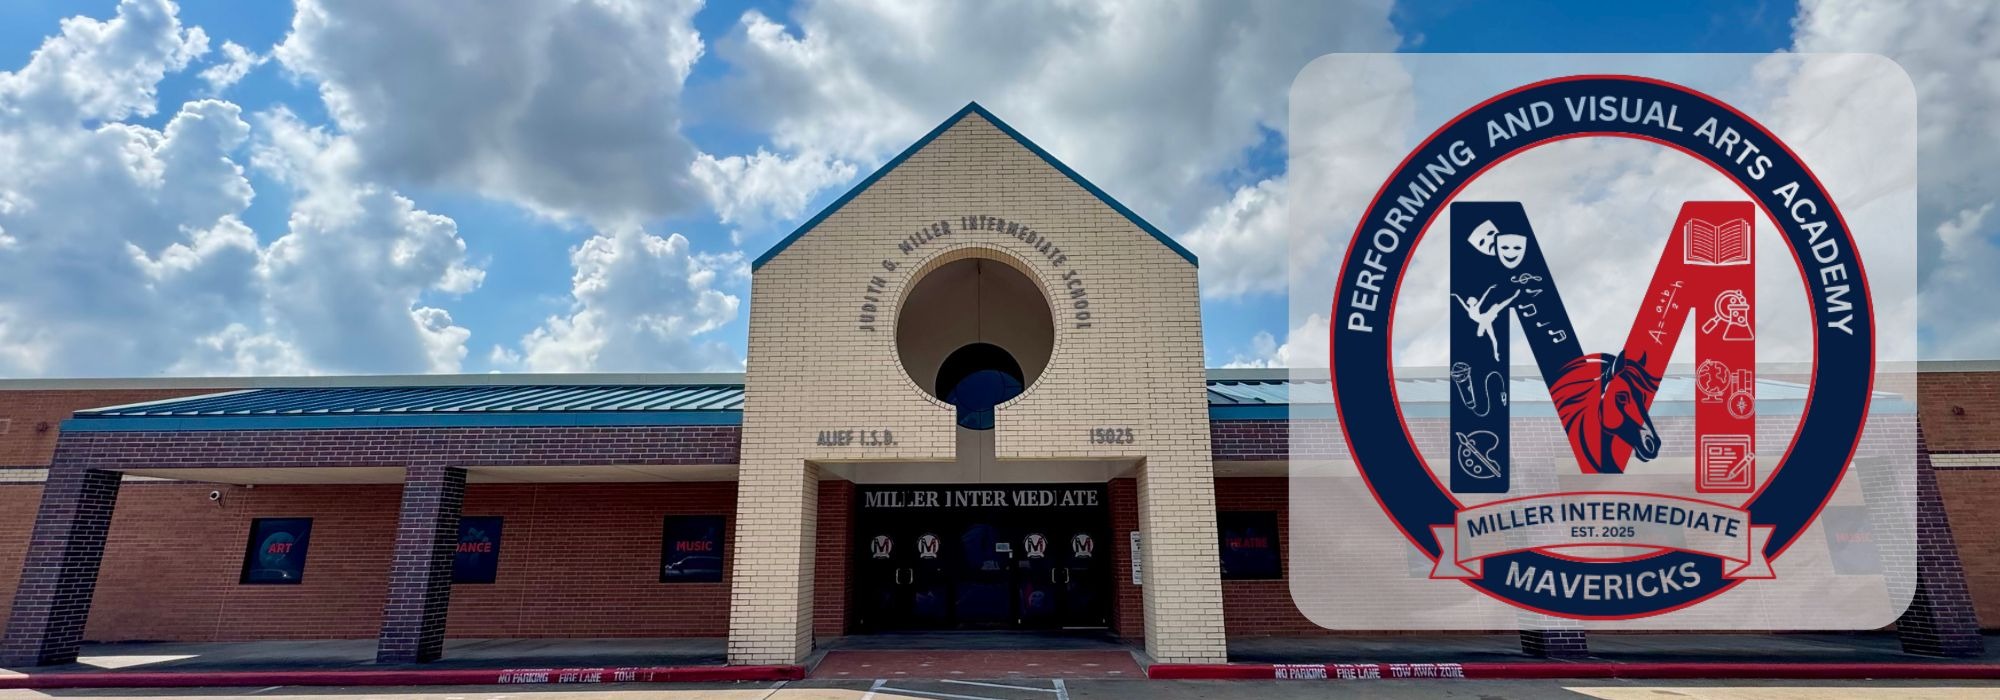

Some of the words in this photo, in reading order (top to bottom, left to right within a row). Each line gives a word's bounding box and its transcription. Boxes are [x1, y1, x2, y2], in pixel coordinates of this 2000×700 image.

[859, 276, 887, 332] JUDITH
[898, 219, 951, 255] MILLER
[961, 214, 1067, 268] INTERMEDIATE
[1062, 269, 1092, 329] SCHOOL
[816, 430, 854, 446] ALIEF
[1089, 427, 1135, 444] 15025
[268, 542, 293, 553] ART
[676, 541, 713, 552] MUSIC
[498, 672, 511, 684] NO
[512, 671, 549, 684] PARKING
[579, 672, 602, 683] LANE
[1275, 668, 1287, 679] NO
[1290, 668, 1327, 679] PARKING
[1337, 668, 1356, 679] FIRE
[1357, 668, 1381, 679] LANE
[1391, 667, 1411, 678] TOW
[1414, 667, 1437, 678] AWAY
[1440, 667, 1464, 678] ZONE
